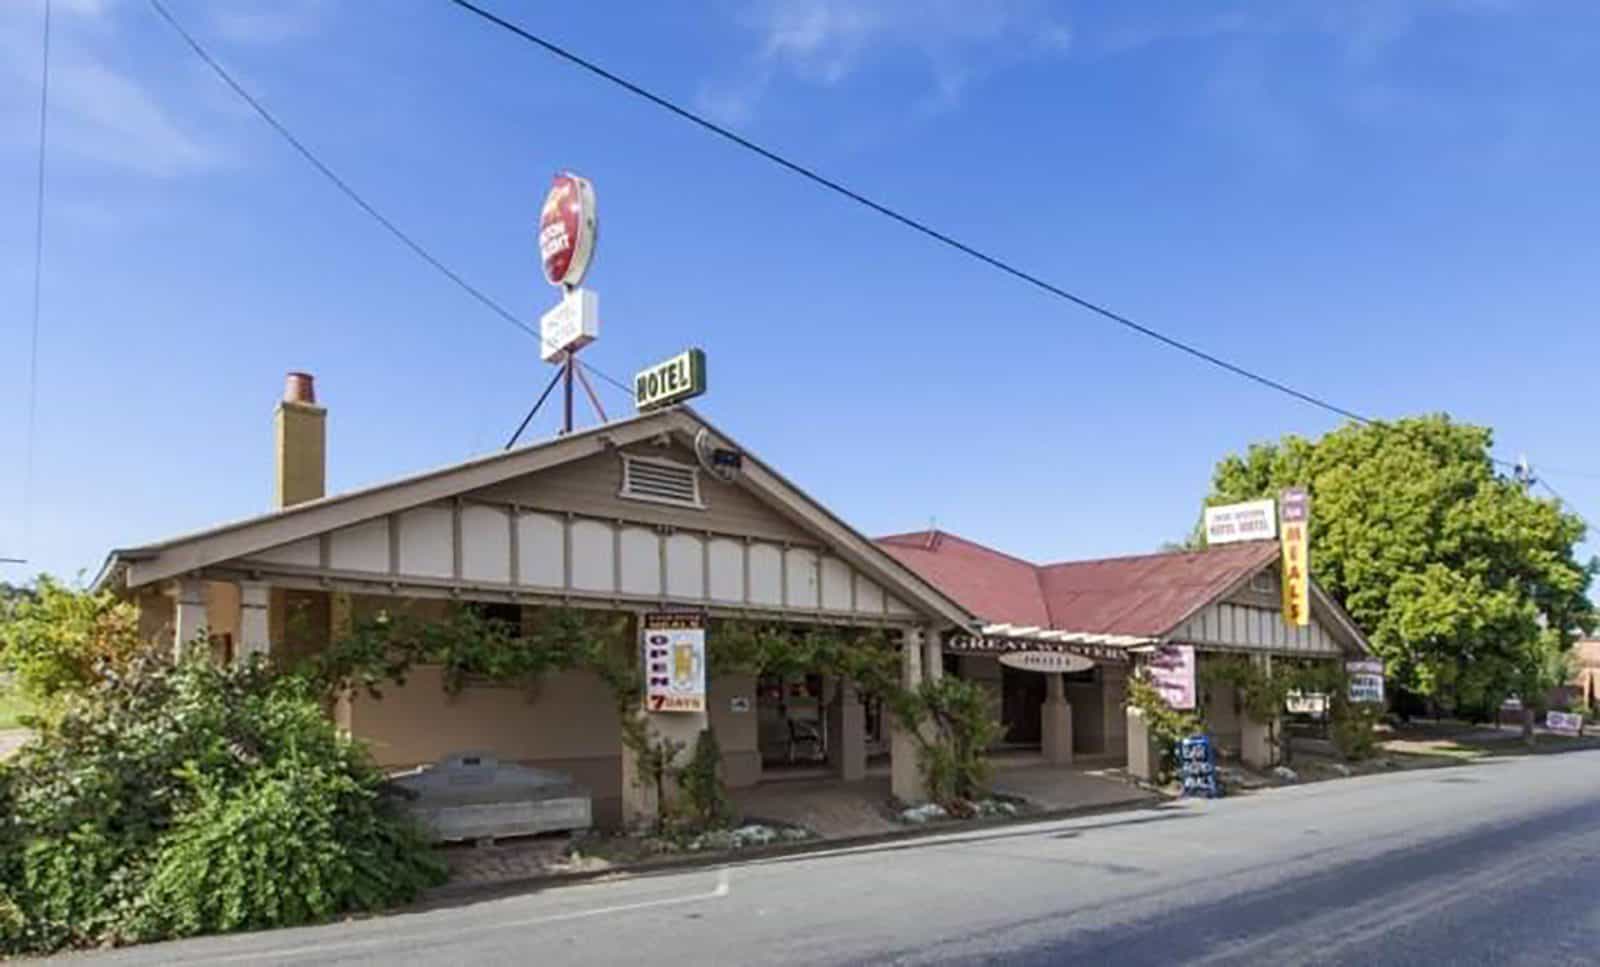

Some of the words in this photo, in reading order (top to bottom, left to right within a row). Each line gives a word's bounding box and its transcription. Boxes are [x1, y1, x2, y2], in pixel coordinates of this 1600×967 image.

[637, 358, 688, 402] HOTEL
[1286, 527, 1301, 619] MEALS
[650, 635, 669, 686] OPEN
[950, 635, 1027, 650] GREAT
[1037, 643, 1130, 661] WESTERN
[651, 694, 665, 709] 7
[666, 698, 700, 708] DAYS
